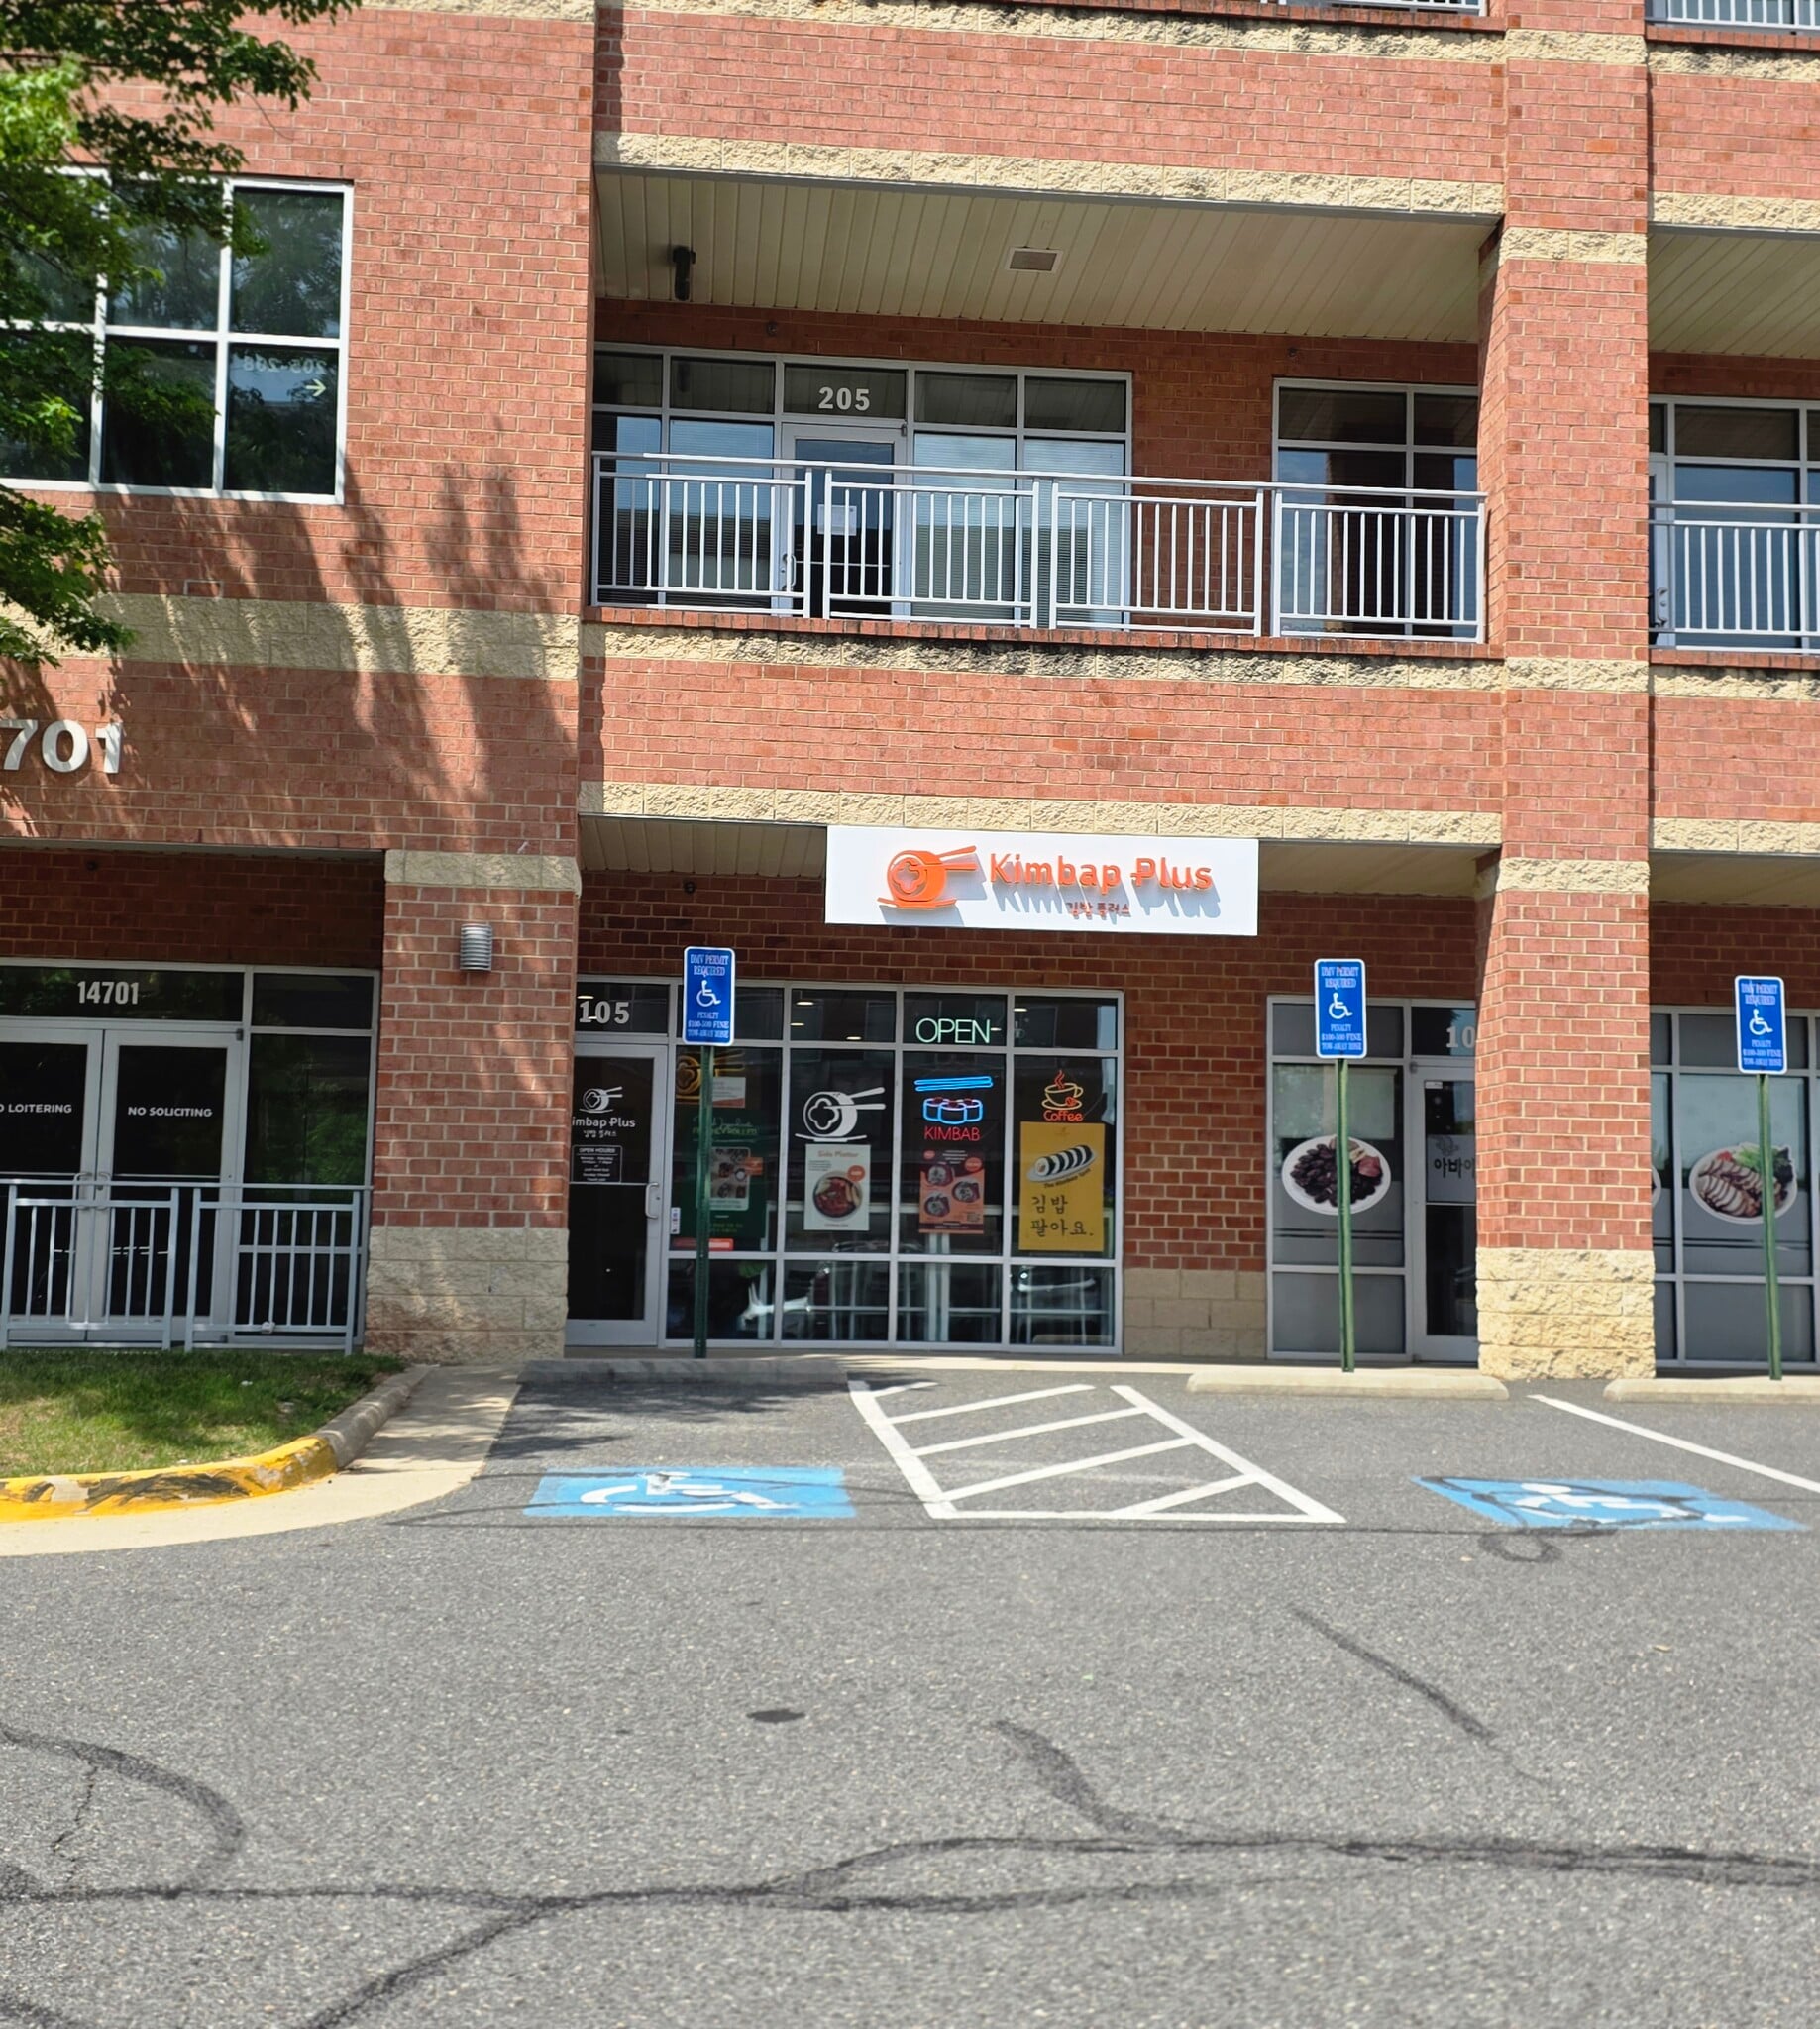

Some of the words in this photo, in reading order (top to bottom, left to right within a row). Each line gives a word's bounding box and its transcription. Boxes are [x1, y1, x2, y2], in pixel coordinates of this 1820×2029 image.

[818, 386, 870, 411] 205
[0, 719, 121, 774] 701
[991, 853, 1122, 896] Kimbap
[1130, 857, 1213, 890] Plus
[705, 955, 729, 965] PERMIT
[694, 966, 725, 977] REQUIRED
[77, 981, 139, 1005] 14701
[579, 1000, 630, 1024] 105
[915, 1017, 991, 1044] OPEN
[1445, 1025, 1476, 1048] 10
[8, 1104, 72, 1114] LOITERING
[128, 1106, 147, 1116] NO
[149, 1107, 213, 1118] SOLICITING
[1043, 1110, 1084, 1122] Coffee
[572, 1117, 607, 1129] imbap
[609, 1118, 636, 1128] Plus
[924, 1125, 981, 1141] KIMBAB
[1031, 1194, 1069, 1215] 김밥
